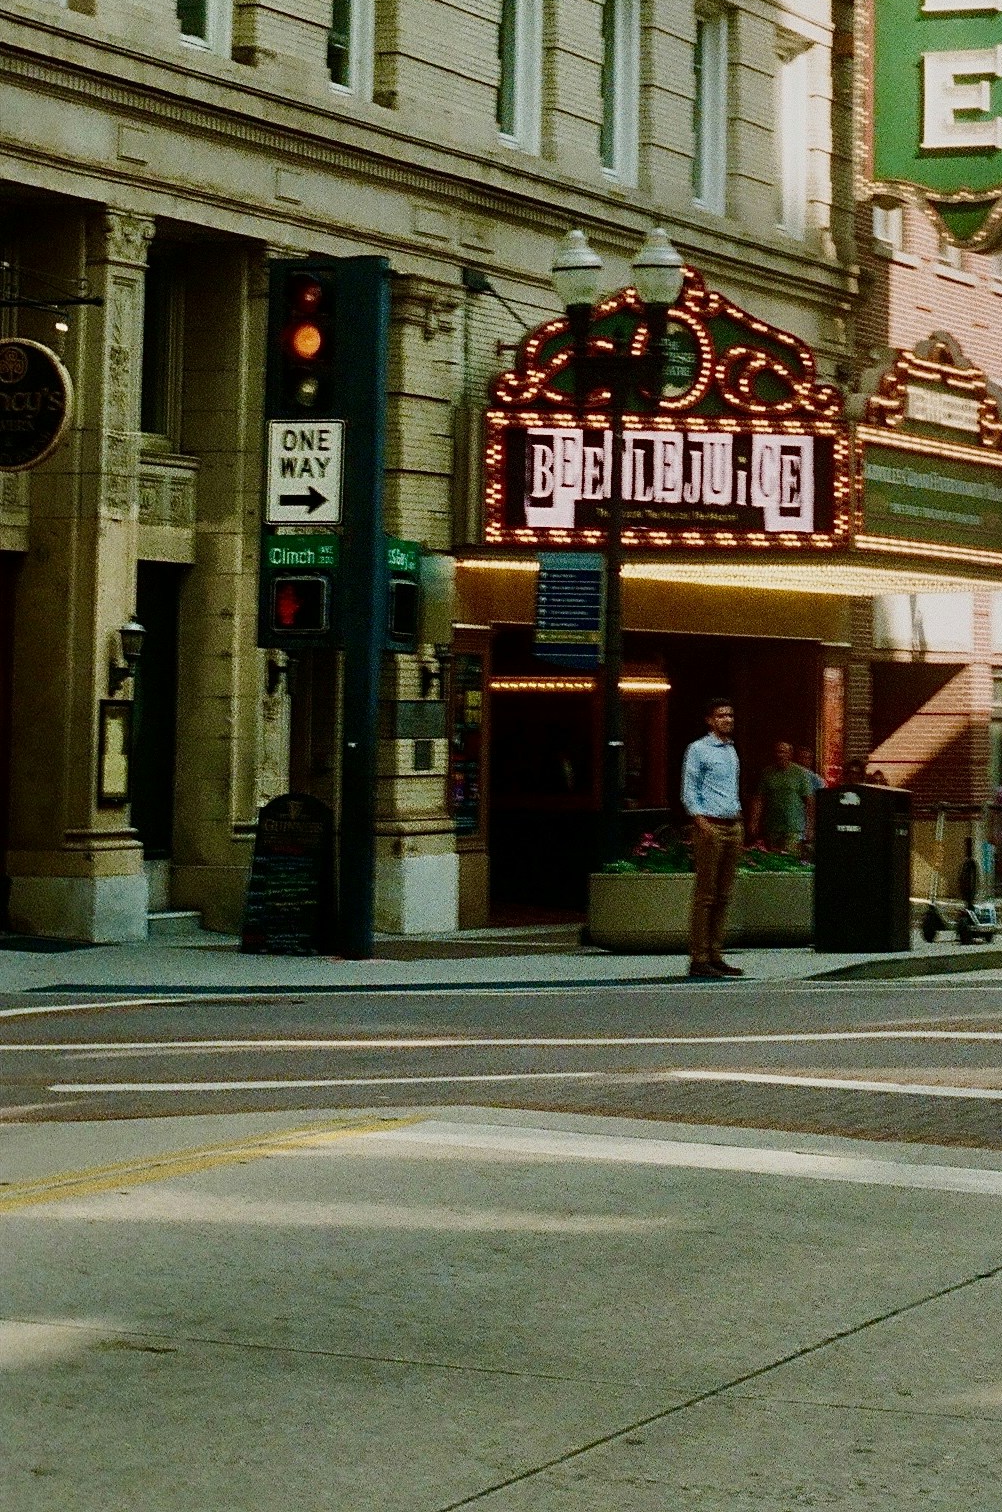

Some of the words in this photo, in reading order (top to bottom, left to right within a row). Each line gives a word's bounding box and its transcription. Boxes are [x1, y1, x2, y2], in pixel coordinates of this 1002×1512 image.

[282, 429, 331, 451] ONE
[280, 456, 331, 478] WAY
[269, 547, 316, 565] Clinch
